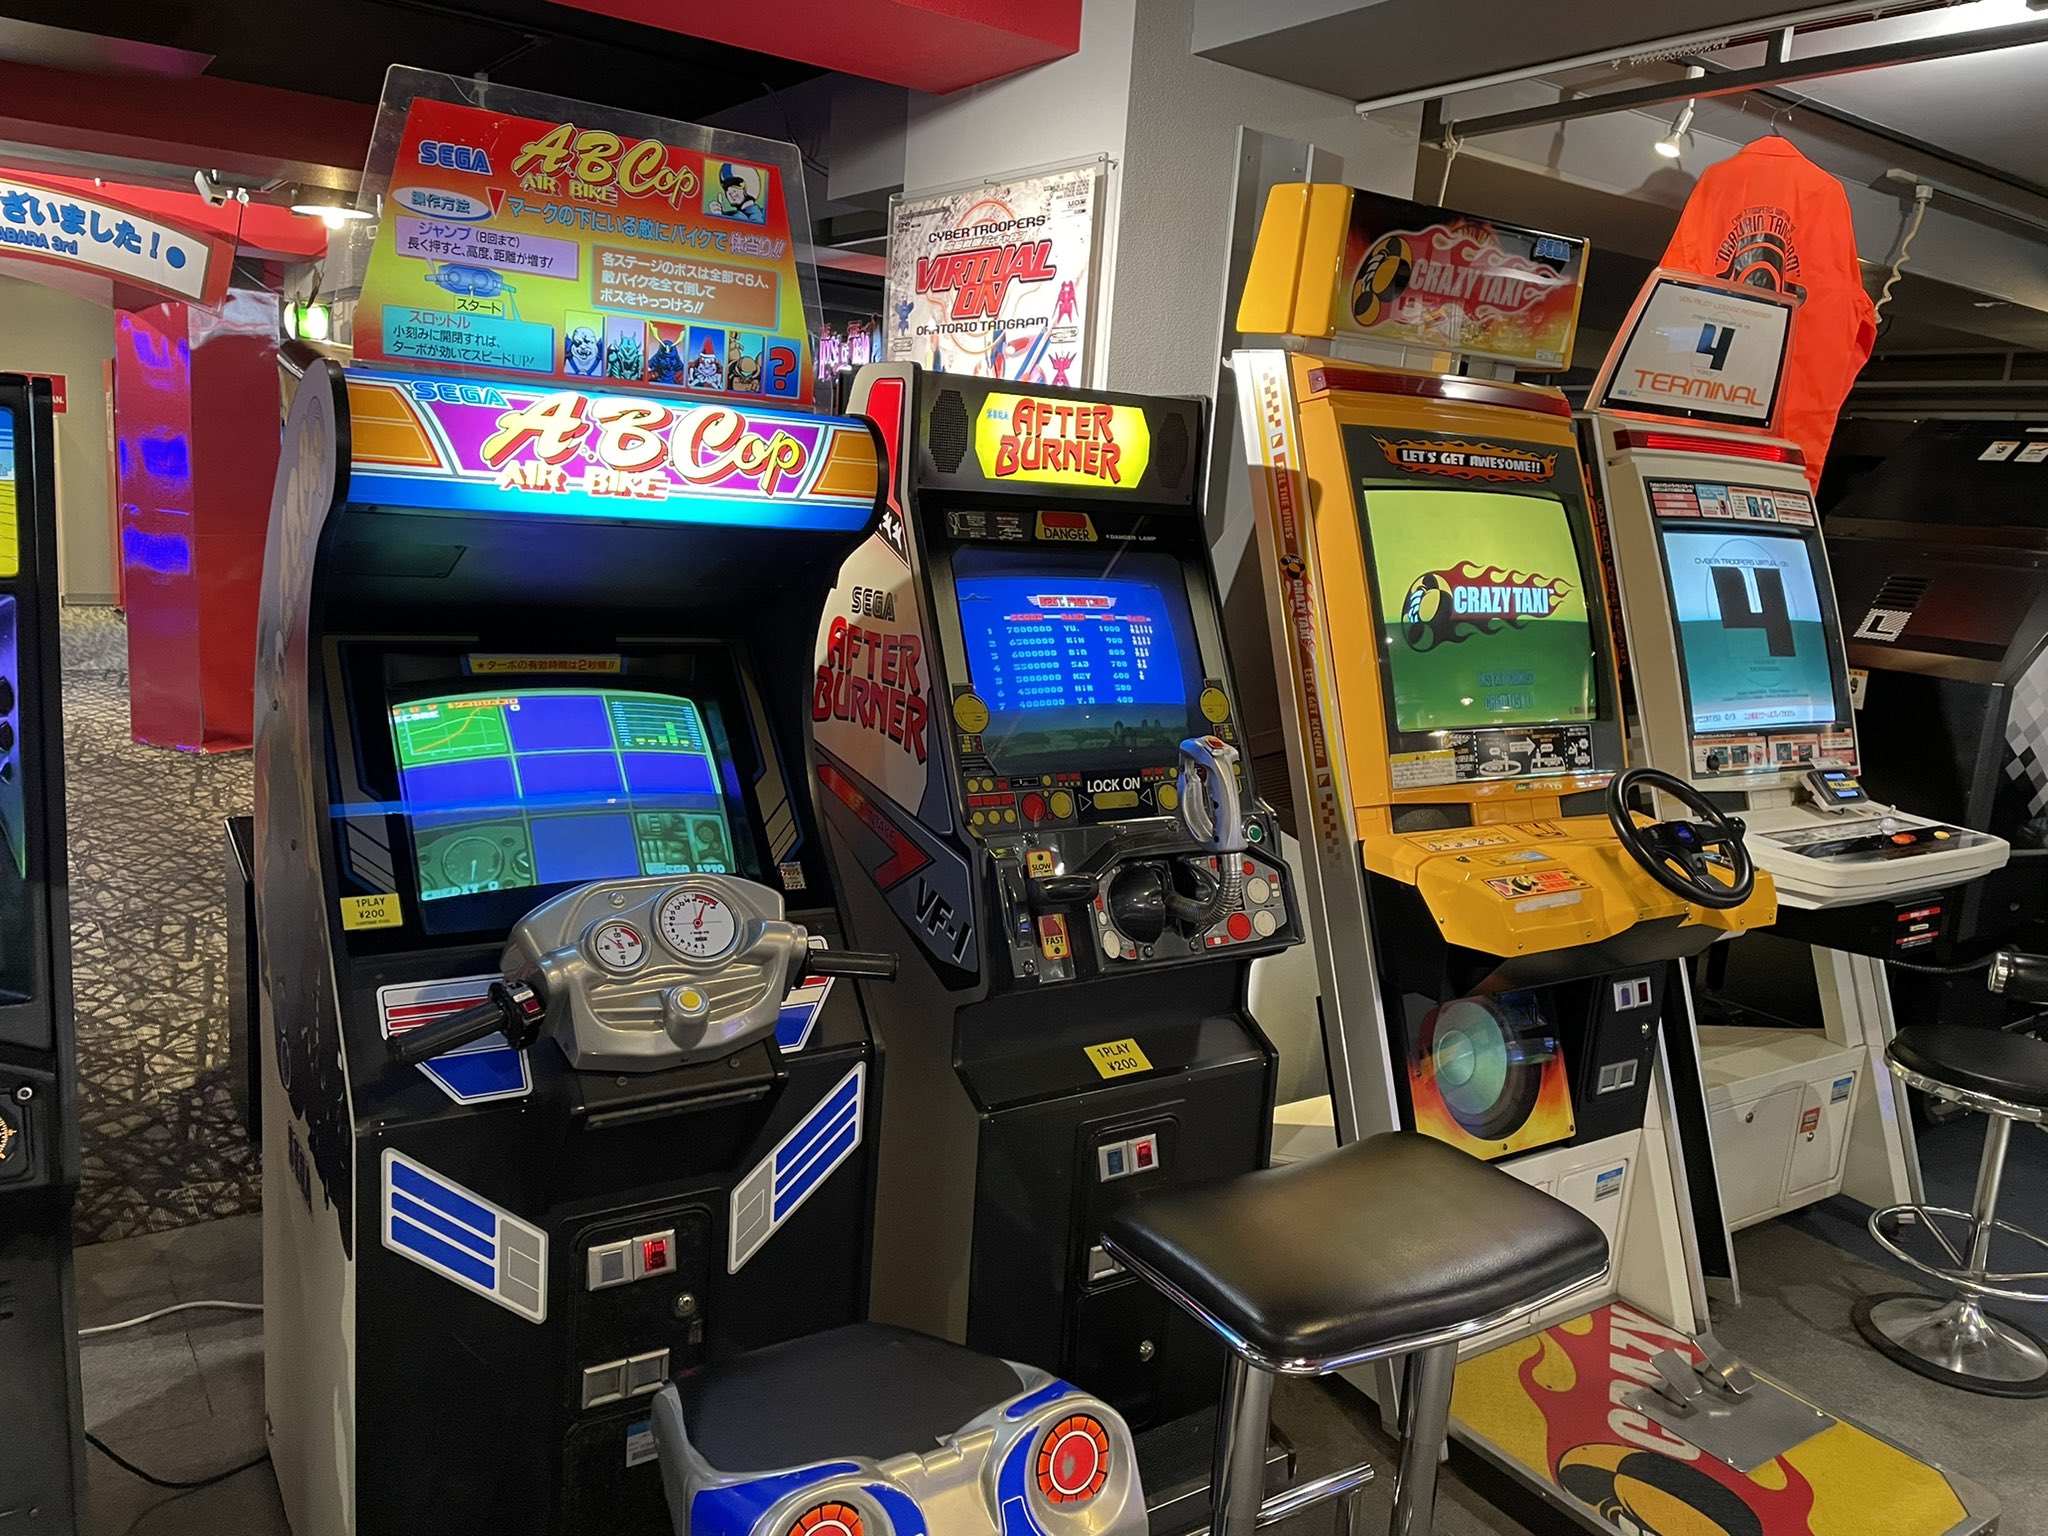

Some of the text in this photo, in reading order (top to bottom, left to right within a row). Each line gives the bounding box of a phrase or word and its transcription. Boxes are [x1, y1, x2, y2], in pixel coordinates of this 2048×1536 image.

[418, 140, 493, 175] SEGA
[521, 172, 618, 207] AIR BIKE
[419, 221, 472, 241] ジャンプ
[928, 225, 971, 244] CYBER
[974, 214, 1047, 236] TROOPERS
[51, 235, 78, 255] 3rd
[1535, 237, 1571, 263] SEGA
[916, 240, 1057, 295] VIRTUAL
[1409, 258, 1526, 307] CRAZY TAXI
[457, 298, 501, 315] スタート
[951, 279, 1008, 321] ON
[409, 310, 471, 329] スロットル
[980, 316, 1049, 332] TANGRAM
[412, 380, 510, 407] SEGA
[1635, 369, 1764, 407] TERMINAL
[1012, 398, 1115, 442] AFTER
[995, 434, 1122, 484] BURNER
[1402, 449, 1541, 474] LET'S GET AWESOME!!
[499, 460, 672, 501] AIR BIKE
[1044, 527, 1091, 541] DANGER
[851, 586, 896, 622] SEGA
[1453, 585, 1549, 614] CRAZY TAXI
[828, 615, 922, 695] AFTER
[813, 665, 928, 765] BURNER
[1087, 777, 1141, 793] LOCK ON
[1031, 863, 1051, 873] SLOW
[359, 909, 385, 919] ¥200
[916, 876, 972, 964] VF-1
[1045, 935, 1064, 946] FAST
[1107, 1057, 1138, 1072] ¥200
